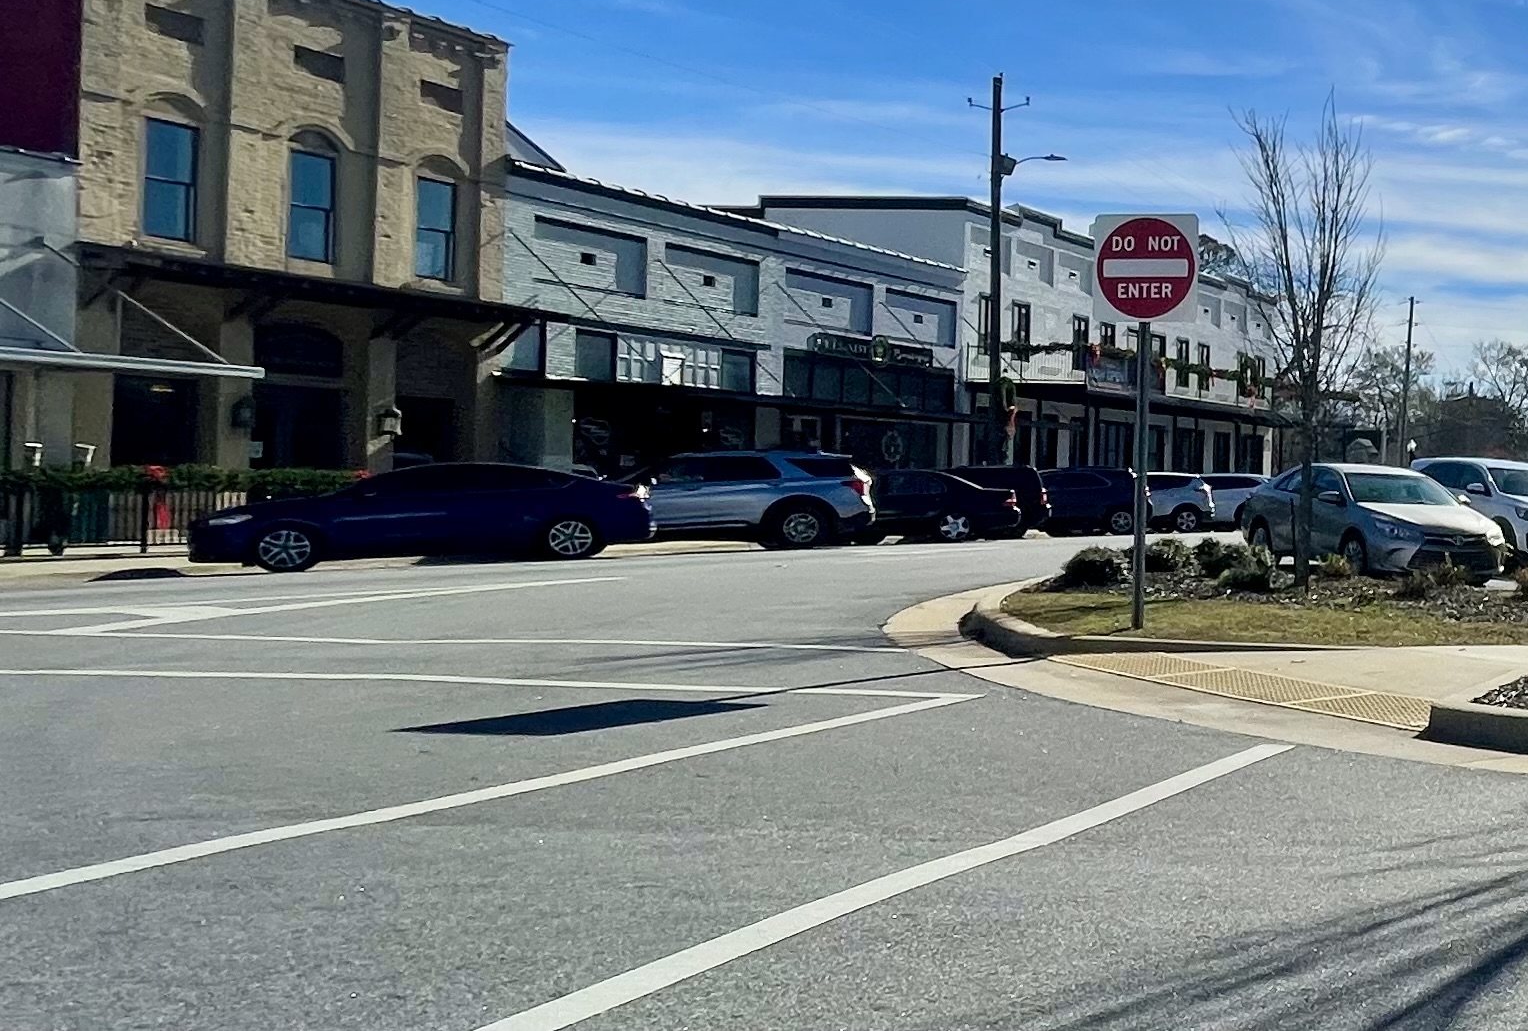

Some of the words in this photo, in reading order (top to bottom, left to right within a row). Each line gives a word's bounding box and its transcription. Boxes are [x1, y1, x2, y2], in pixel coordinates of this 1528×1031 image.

[1112, 236, 1135, 251] DO
[1148, 236, 1180, 251] NOT
[1117, 283, 1172, 299] ENTER
